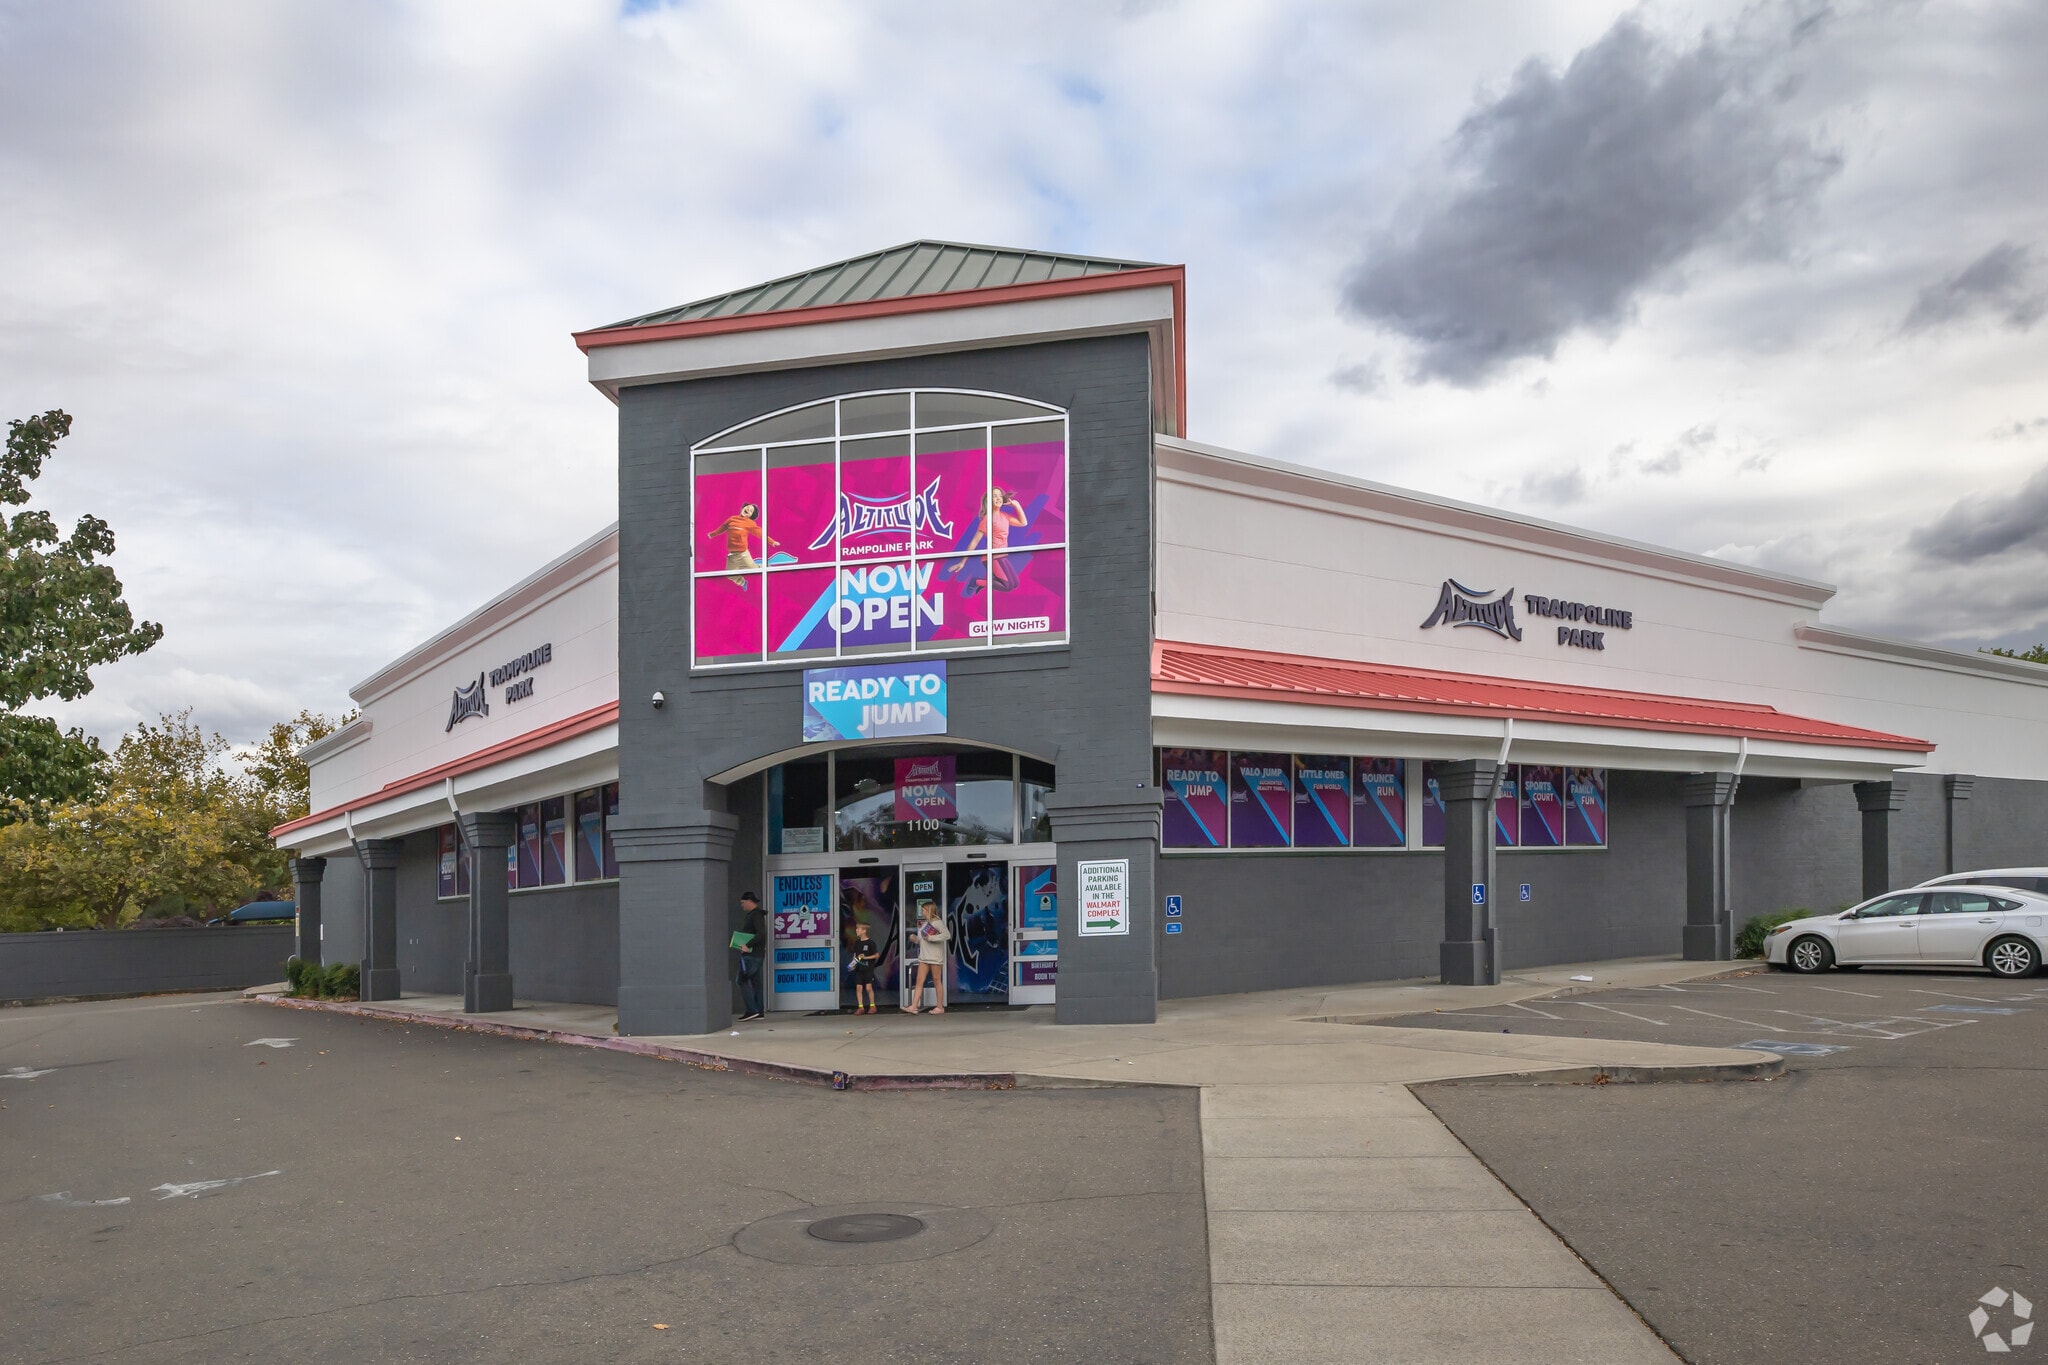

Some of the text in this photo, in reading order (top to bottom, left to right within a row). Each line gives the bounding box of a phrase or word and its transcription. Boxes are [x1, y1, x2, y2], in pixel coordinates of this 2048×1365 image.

[808, 475, 953, 550] ALTITUDE
[842, 543, 903, 556] RAMPOLINE
[841, 562, 934, 596] NOW
[828, 592, 944, 633] OPEN
[1420, 581, 1632, 641] ALTITUDE TRAMPOLINE
[1008, 620, 1046, 630] NIGHTS
[1558, 627, 1604, 650] PARK
[489, 643, 552, 687] TRAMPOLINE
[506, 677, 534, 704] PARK
[809, 673, 941, 703] READY TO
[857, 701, 931, 732] JUMP
[1167, 769, 1219, 782] READY TO
[1262, 768, 1283, 778] JUMP
[1299, 769, 1345, 779] LITTLE ONES
[1362, 773, 1394, 783] BOUNCE
[902, 784, 938, 798] NOW
[1184, 784, 1213, 798] JUMP
[1377, 786, 1395, 796] RUN
[1525, 781, 1552, 790] SPORTS
[1571, 784, 1594, 794] FAMILY
[915, 797, 945, 806] OPEN
[1533, 793, 1554, 801] COURT
[1581, 796, 1595, 805] FUN
[907, 819, 939, 831] 1100
[1083, 866, 1123, 874] ADDITIONAL
[779, 875, 822, 891] ENDLESS
[914, 883, 933, 892] OPEN
[1085, 883, 1122, 891] AVAILABLE
[782, 892, 818, 907] JUMPS
[1087, 909, 1120, 917] COMPLEX
[777, 951, 825, 961] GROUP EVENTS
[777, 972, 827, 984] BOOK THE PARK
